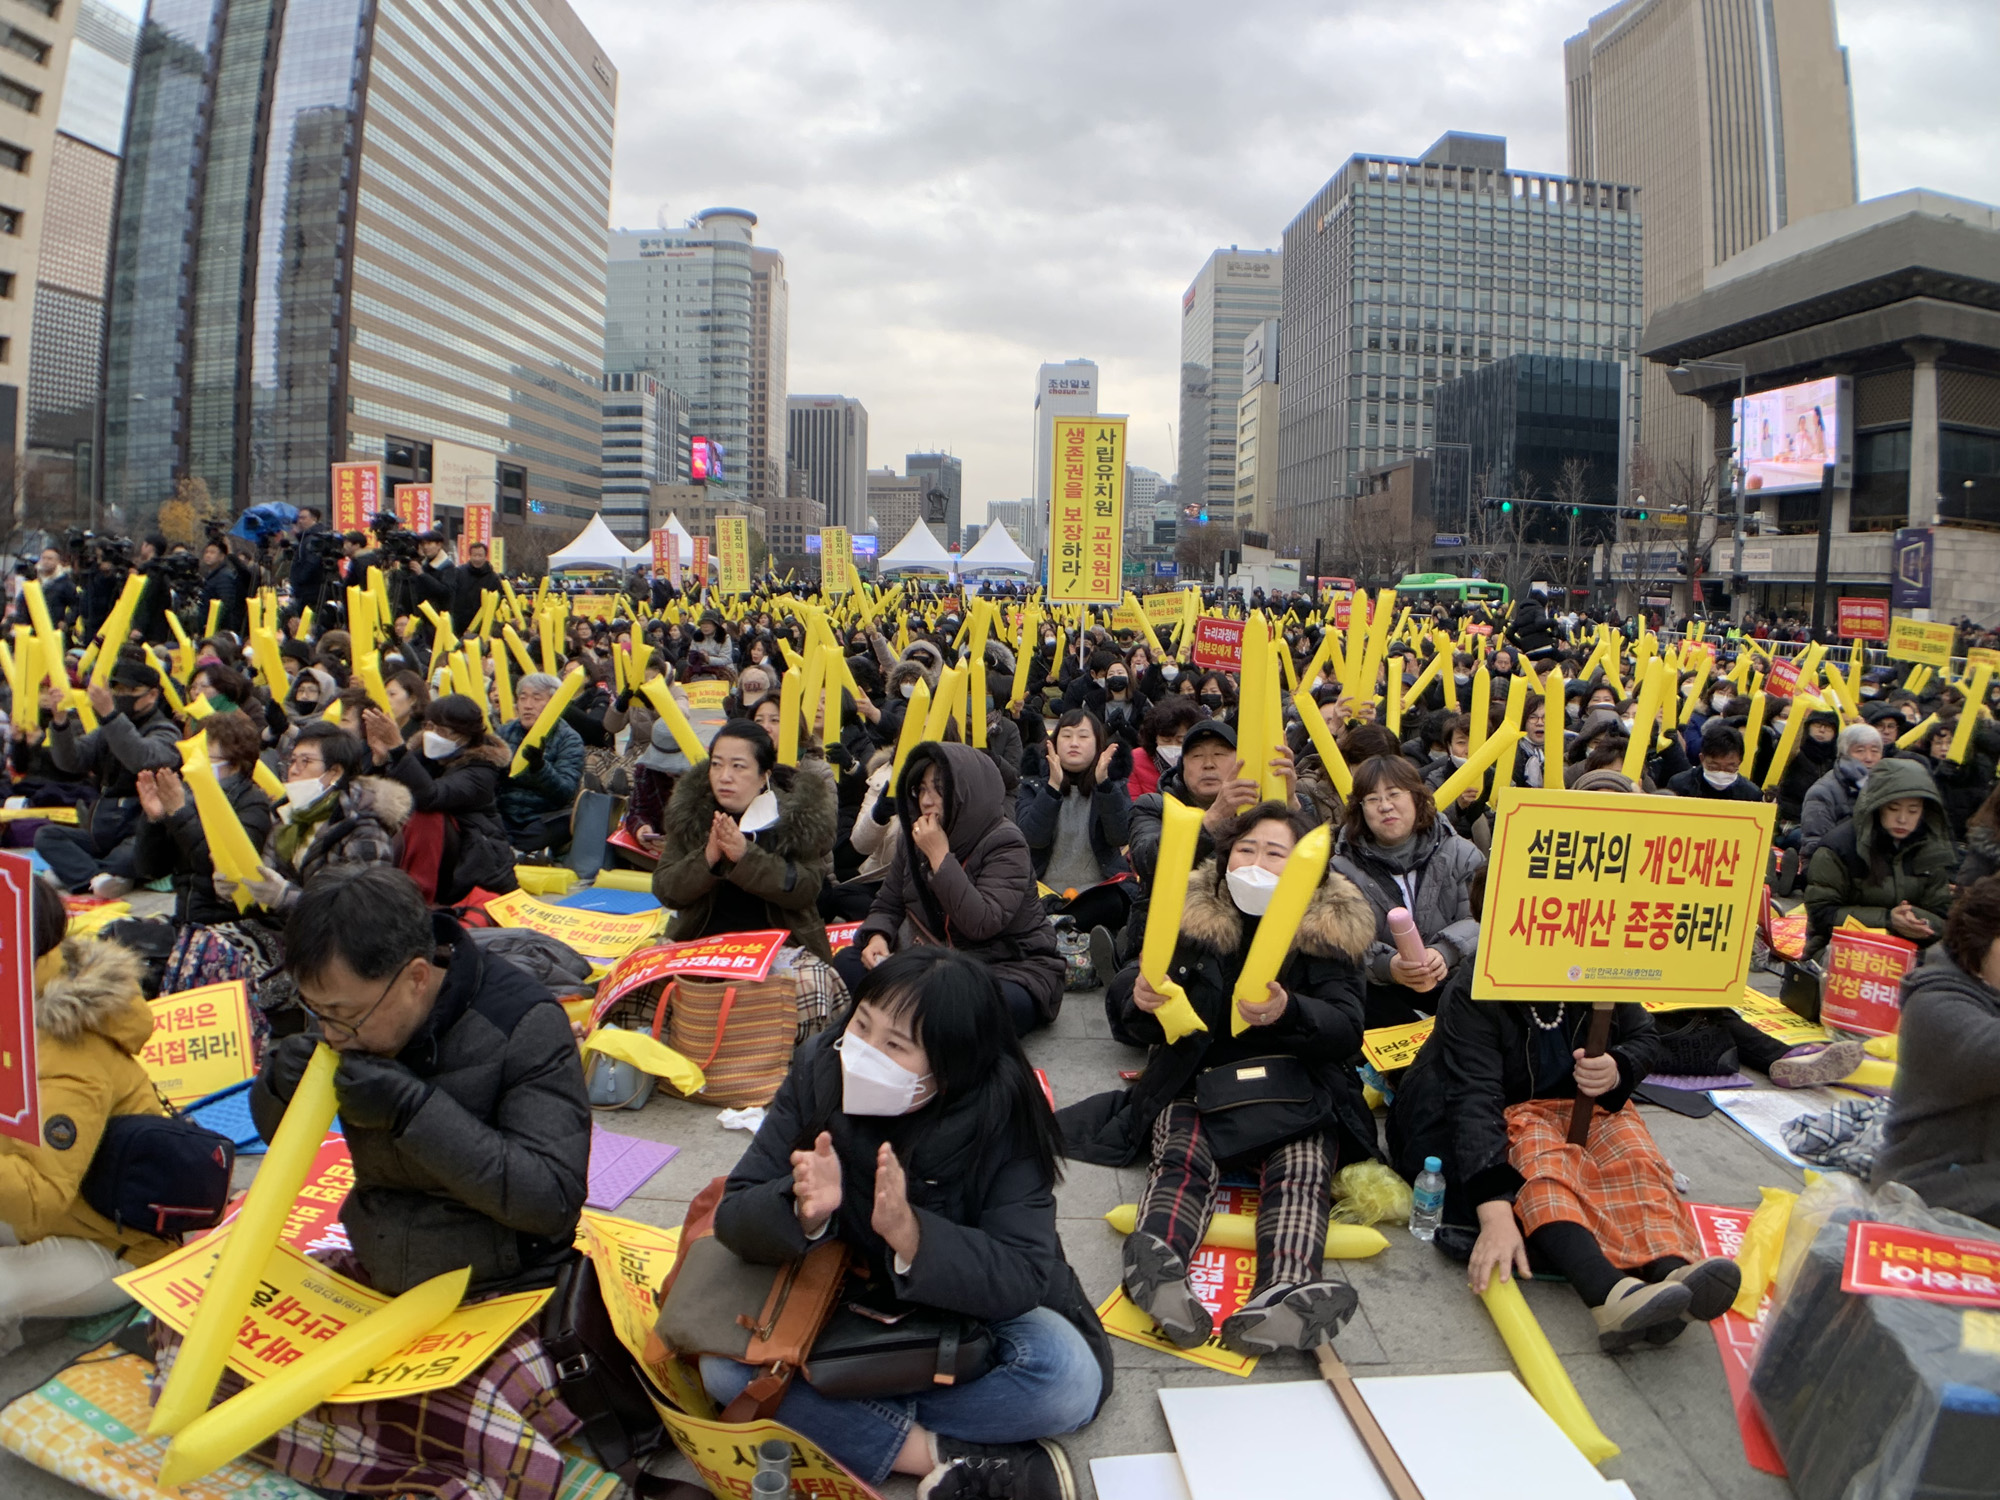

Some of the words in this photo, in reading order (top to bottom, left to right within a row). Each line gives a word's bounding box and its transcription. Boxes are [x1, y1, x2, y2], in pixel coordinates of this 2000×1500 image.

[1048, 379, 1091, 389] 조선일보
[1063, 427, 1085, 499] 생존권을
[1093, 428, 1117, 517] 사립유치원
[721, 520, 731, 549] 사유재산
[733, 520, 743, 549] 설립자의
[1061, 507, 1084, 593] 보장하라!
[1091, 526, 1112, 595] 교직원의
[736, 552, 745, 581] 개인재산
[1197, 640, 1232, 658] 학부모에게
[1204, 625, 1239, 643] 누리과정비
[1527, 829, 1632, 883] 설립자의
[1639, 835, 1740, 887] 개인재산
[520, 903, 581, 927] 대책없는
[584, 920, 644, 933] 사립3법
[1509, 896, 1616, 948] 사유재산
[1624, 902, 1733, 952] 존중하라!
[567, 929, 640, 945] 반대한다!
[675, 943, 766, 958] 유아교육
[664, 955, 756, 968] 대책없는
[1834, 946, 1904, 980] 남발하는
[153, 1003, 217, 1033] 지원은
[142, 1031, 238, 1067] 직접줘라!
